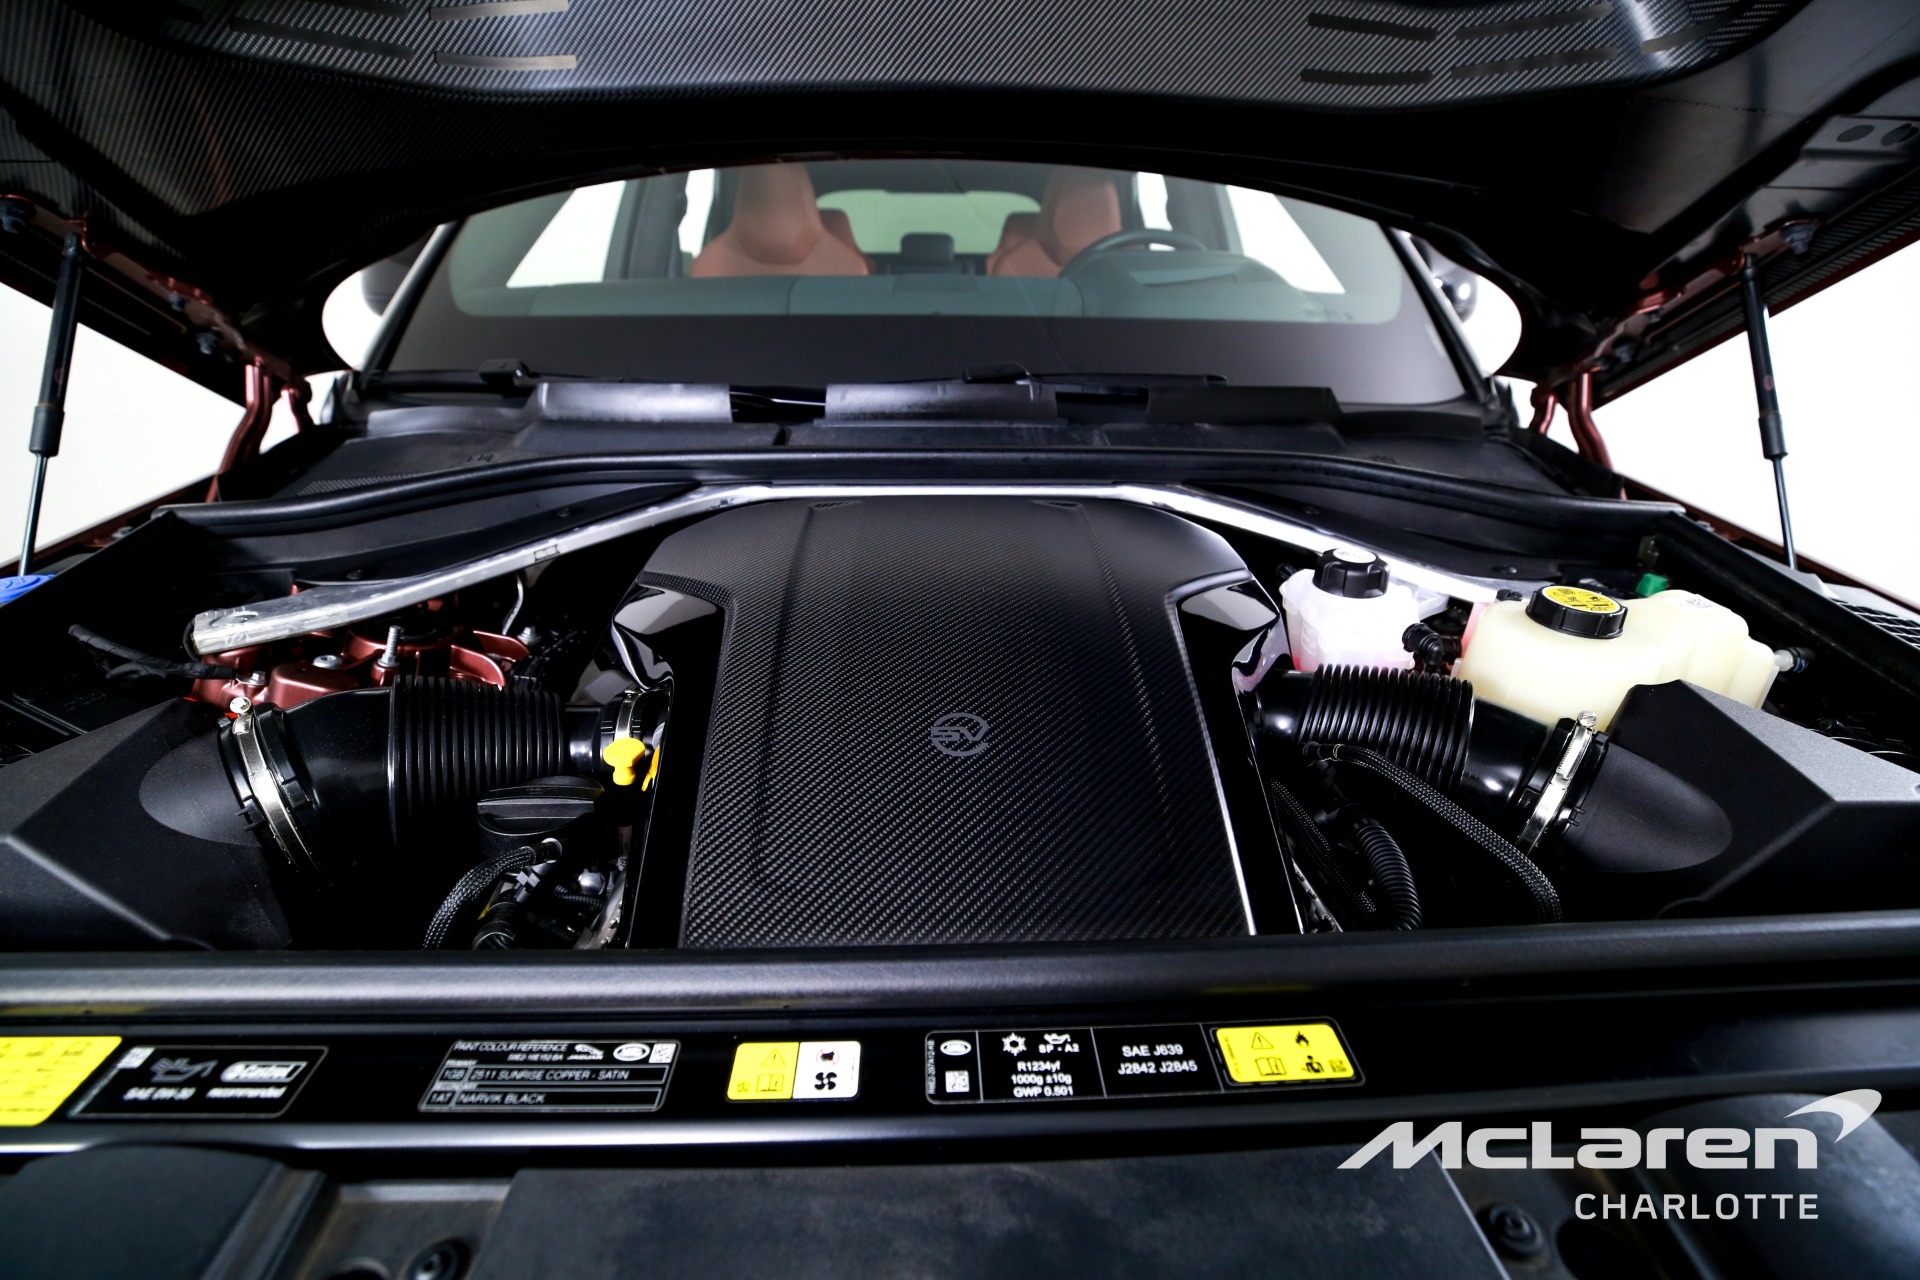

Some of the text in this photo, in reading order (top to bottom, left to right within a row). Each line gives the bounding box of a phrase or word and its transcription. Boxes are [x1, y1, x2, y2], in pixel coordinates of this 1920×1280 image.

[479, 1042, 517, 1052] COLOUR
[516, 1043, 568, 1052] REFERENCE
[1122, 1044, 1184, 1057] SAE J639
[1017, 1060, 1061, 1072] R1234yf
[1118, 1060, 1198, 1075] J2842 J2845
[497, 1070, 545, 1081] SUNRISE
[545, 1070, 591, 1080] COPPER
[598, 1070, 630, 1080] SATIN
[1011, 1074, 1043, 1086] 1000g
[1013, 1087, 1042, 1098] GWP
[504, 1093, 546, 1104] BLACK
